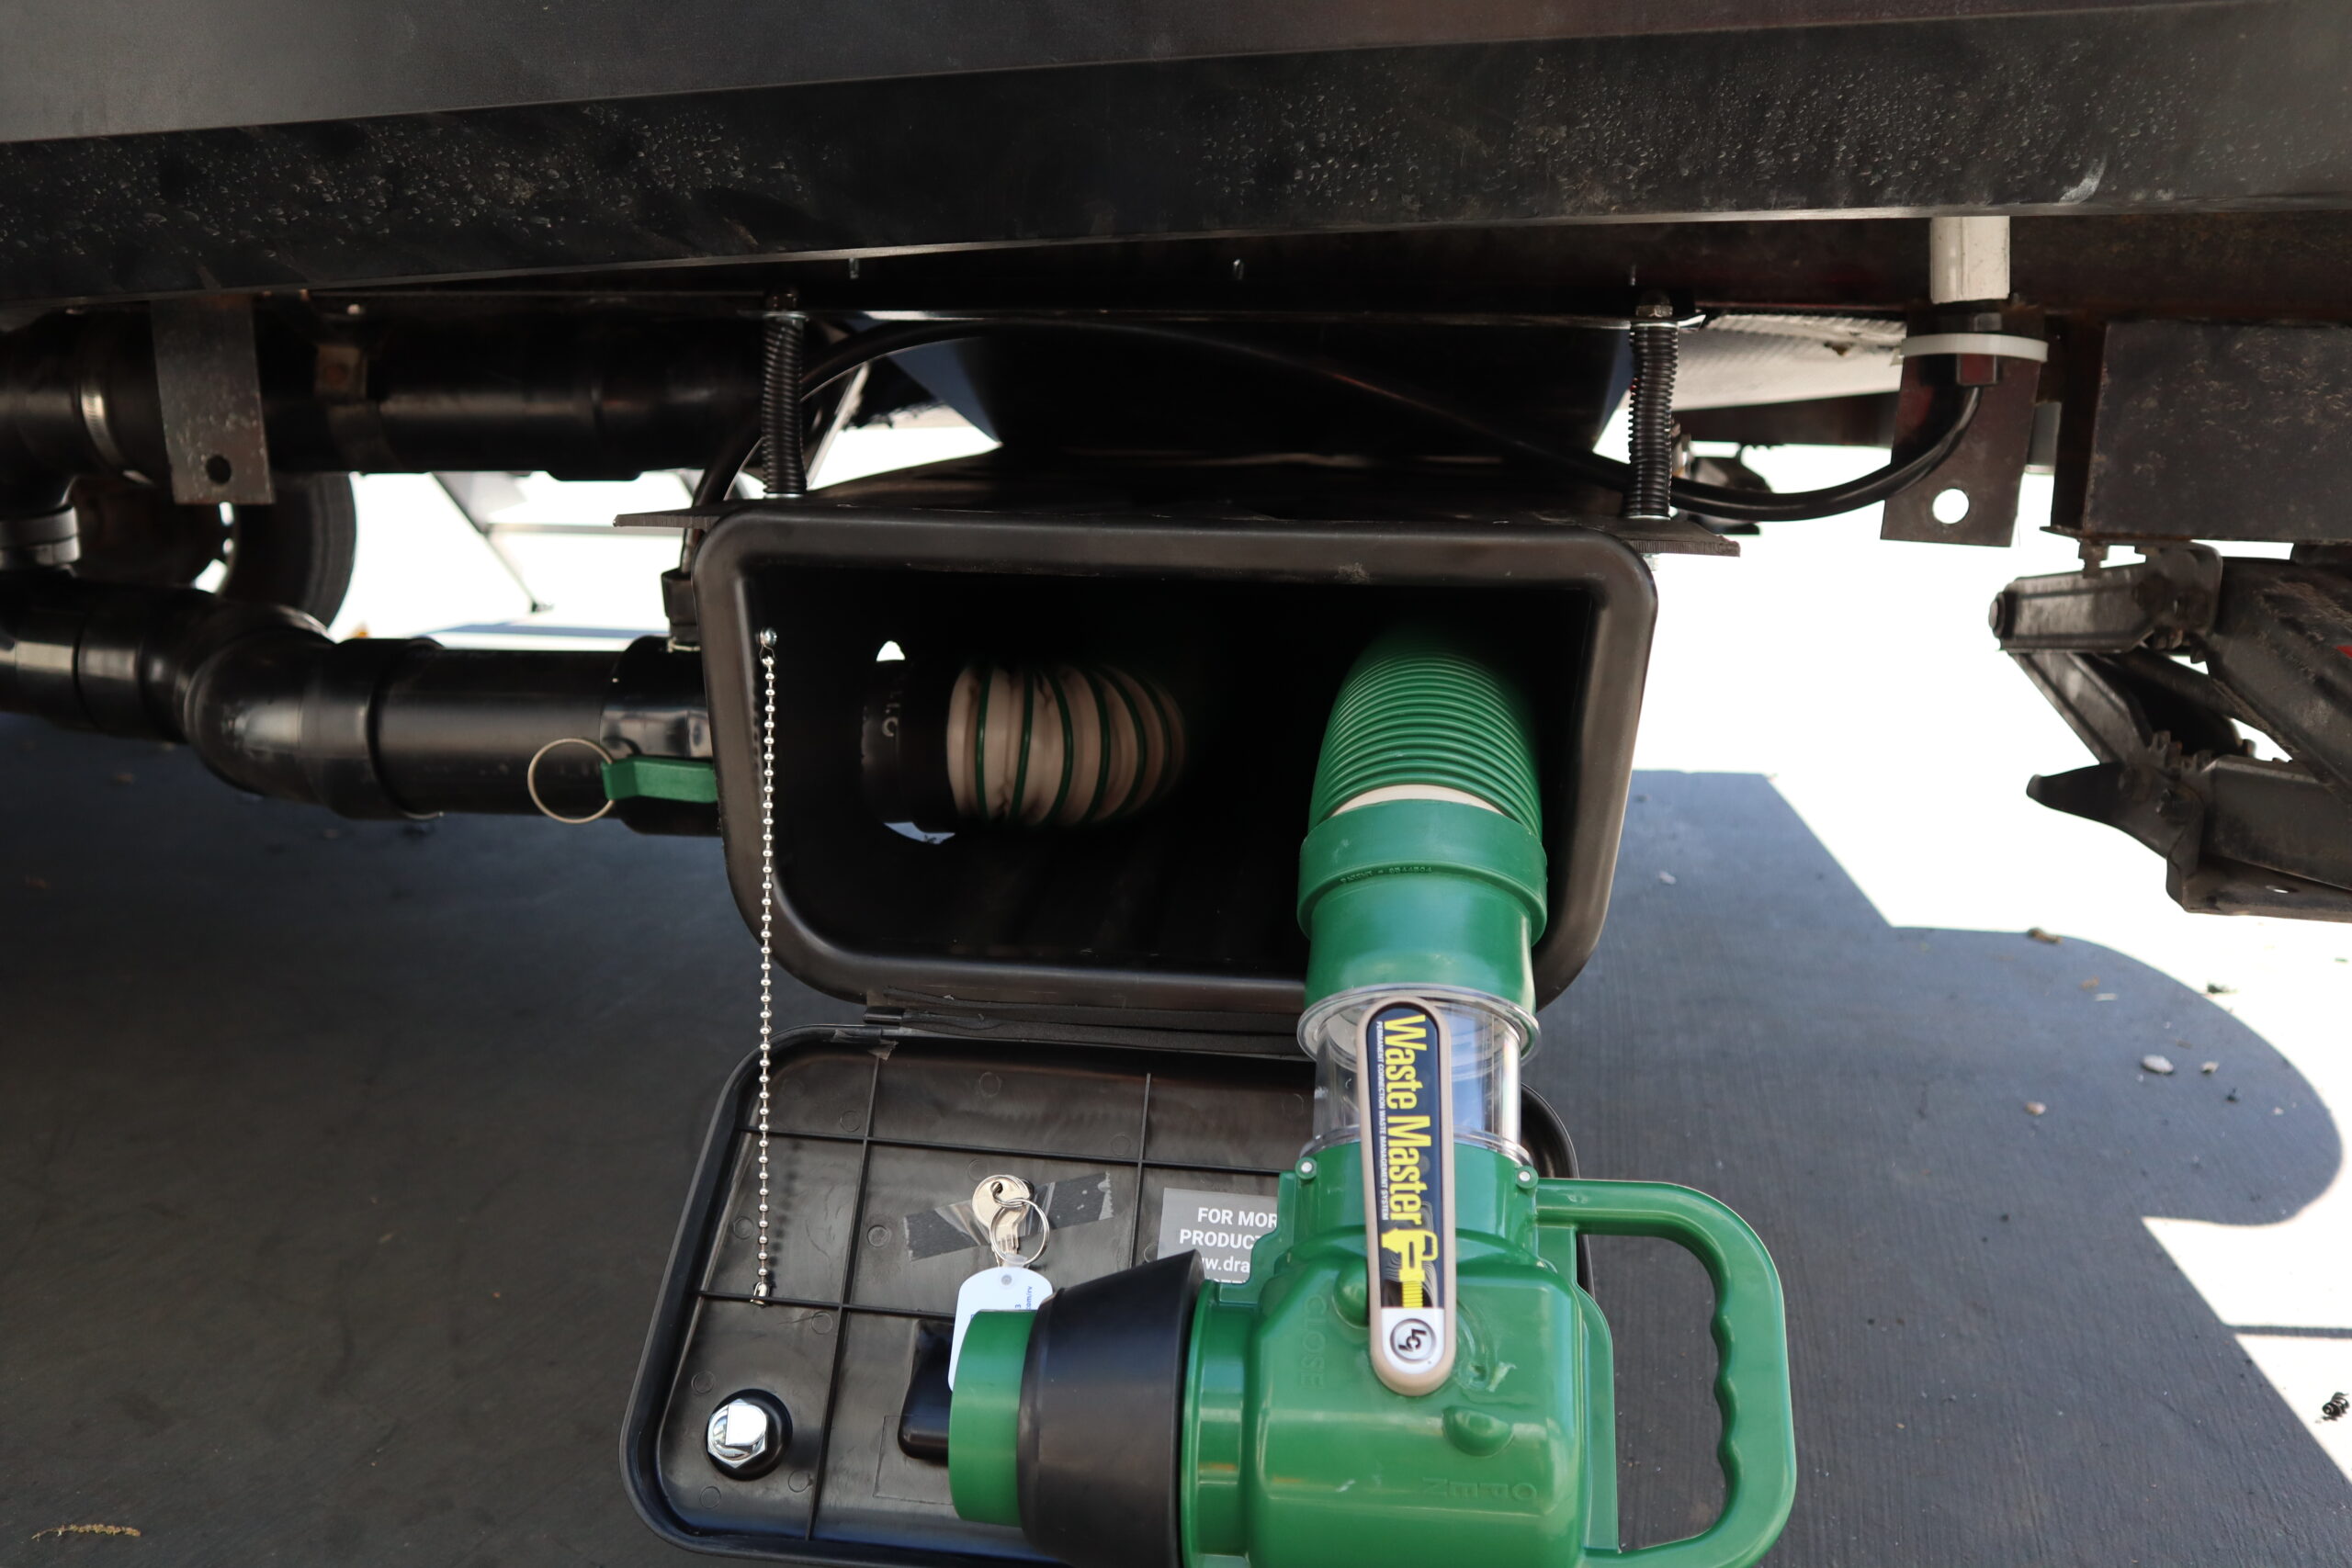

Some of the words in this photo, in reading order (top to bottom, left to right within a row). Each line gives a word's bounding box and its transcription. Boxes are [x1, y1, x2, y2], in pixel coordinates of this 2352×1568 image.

[1376, 1021, 1385, 1063] PERMANENT
[1384, 1014, 1428, 1110] Waste
[1377, 1064, 1386, 1110] CONNECTION
[1379, 1110, 1387, 1134] WASTE
[1380, 1135, 1388, 1189] MANAGEMENT
[1386, 1115, 1432, 1225] Master
[1197, 1207, 1233, 1225] FOR
[1381, 1190, 1389, 1221] SYSTEM
[1301, 1293, 1329, 1389] CLOSE
[1422, 1476, 1537, 1501] OPEN
